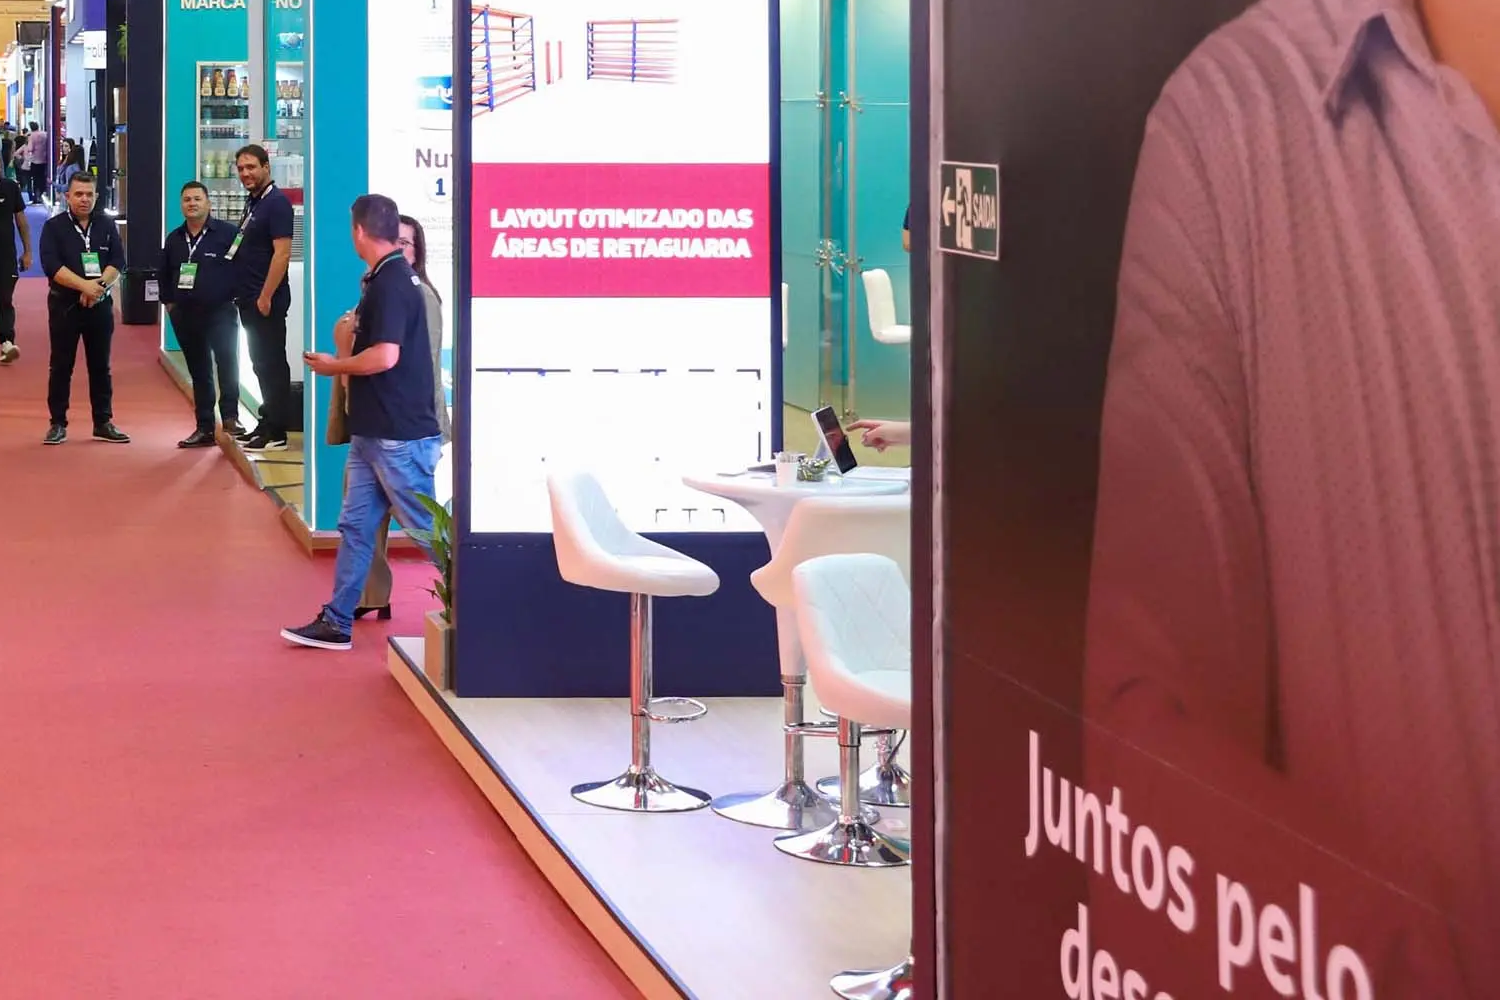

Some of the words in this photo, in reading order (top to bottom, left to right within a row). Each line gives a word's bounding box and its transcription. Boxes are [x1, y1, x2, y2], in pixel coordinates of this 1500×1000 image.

[415, 148, 452, 169] Nu
[435, 178, 446, 195] 1
[490, 208, 577, 228] LAYOUT
[579, 208, 704, 228] OTIMIZADO
[707, 208, 754, 228] DAS
[973, 186, 996, 229] SAÍDA
[492, 233, 568, 258] ÁREAS
[571, 239, 599, 258] DE
[601, 239, 752, 258] RETAGUARDA
[1024, 729, 1198, 934] Juntos
[1216, 872, 1373, 1000] pelo
